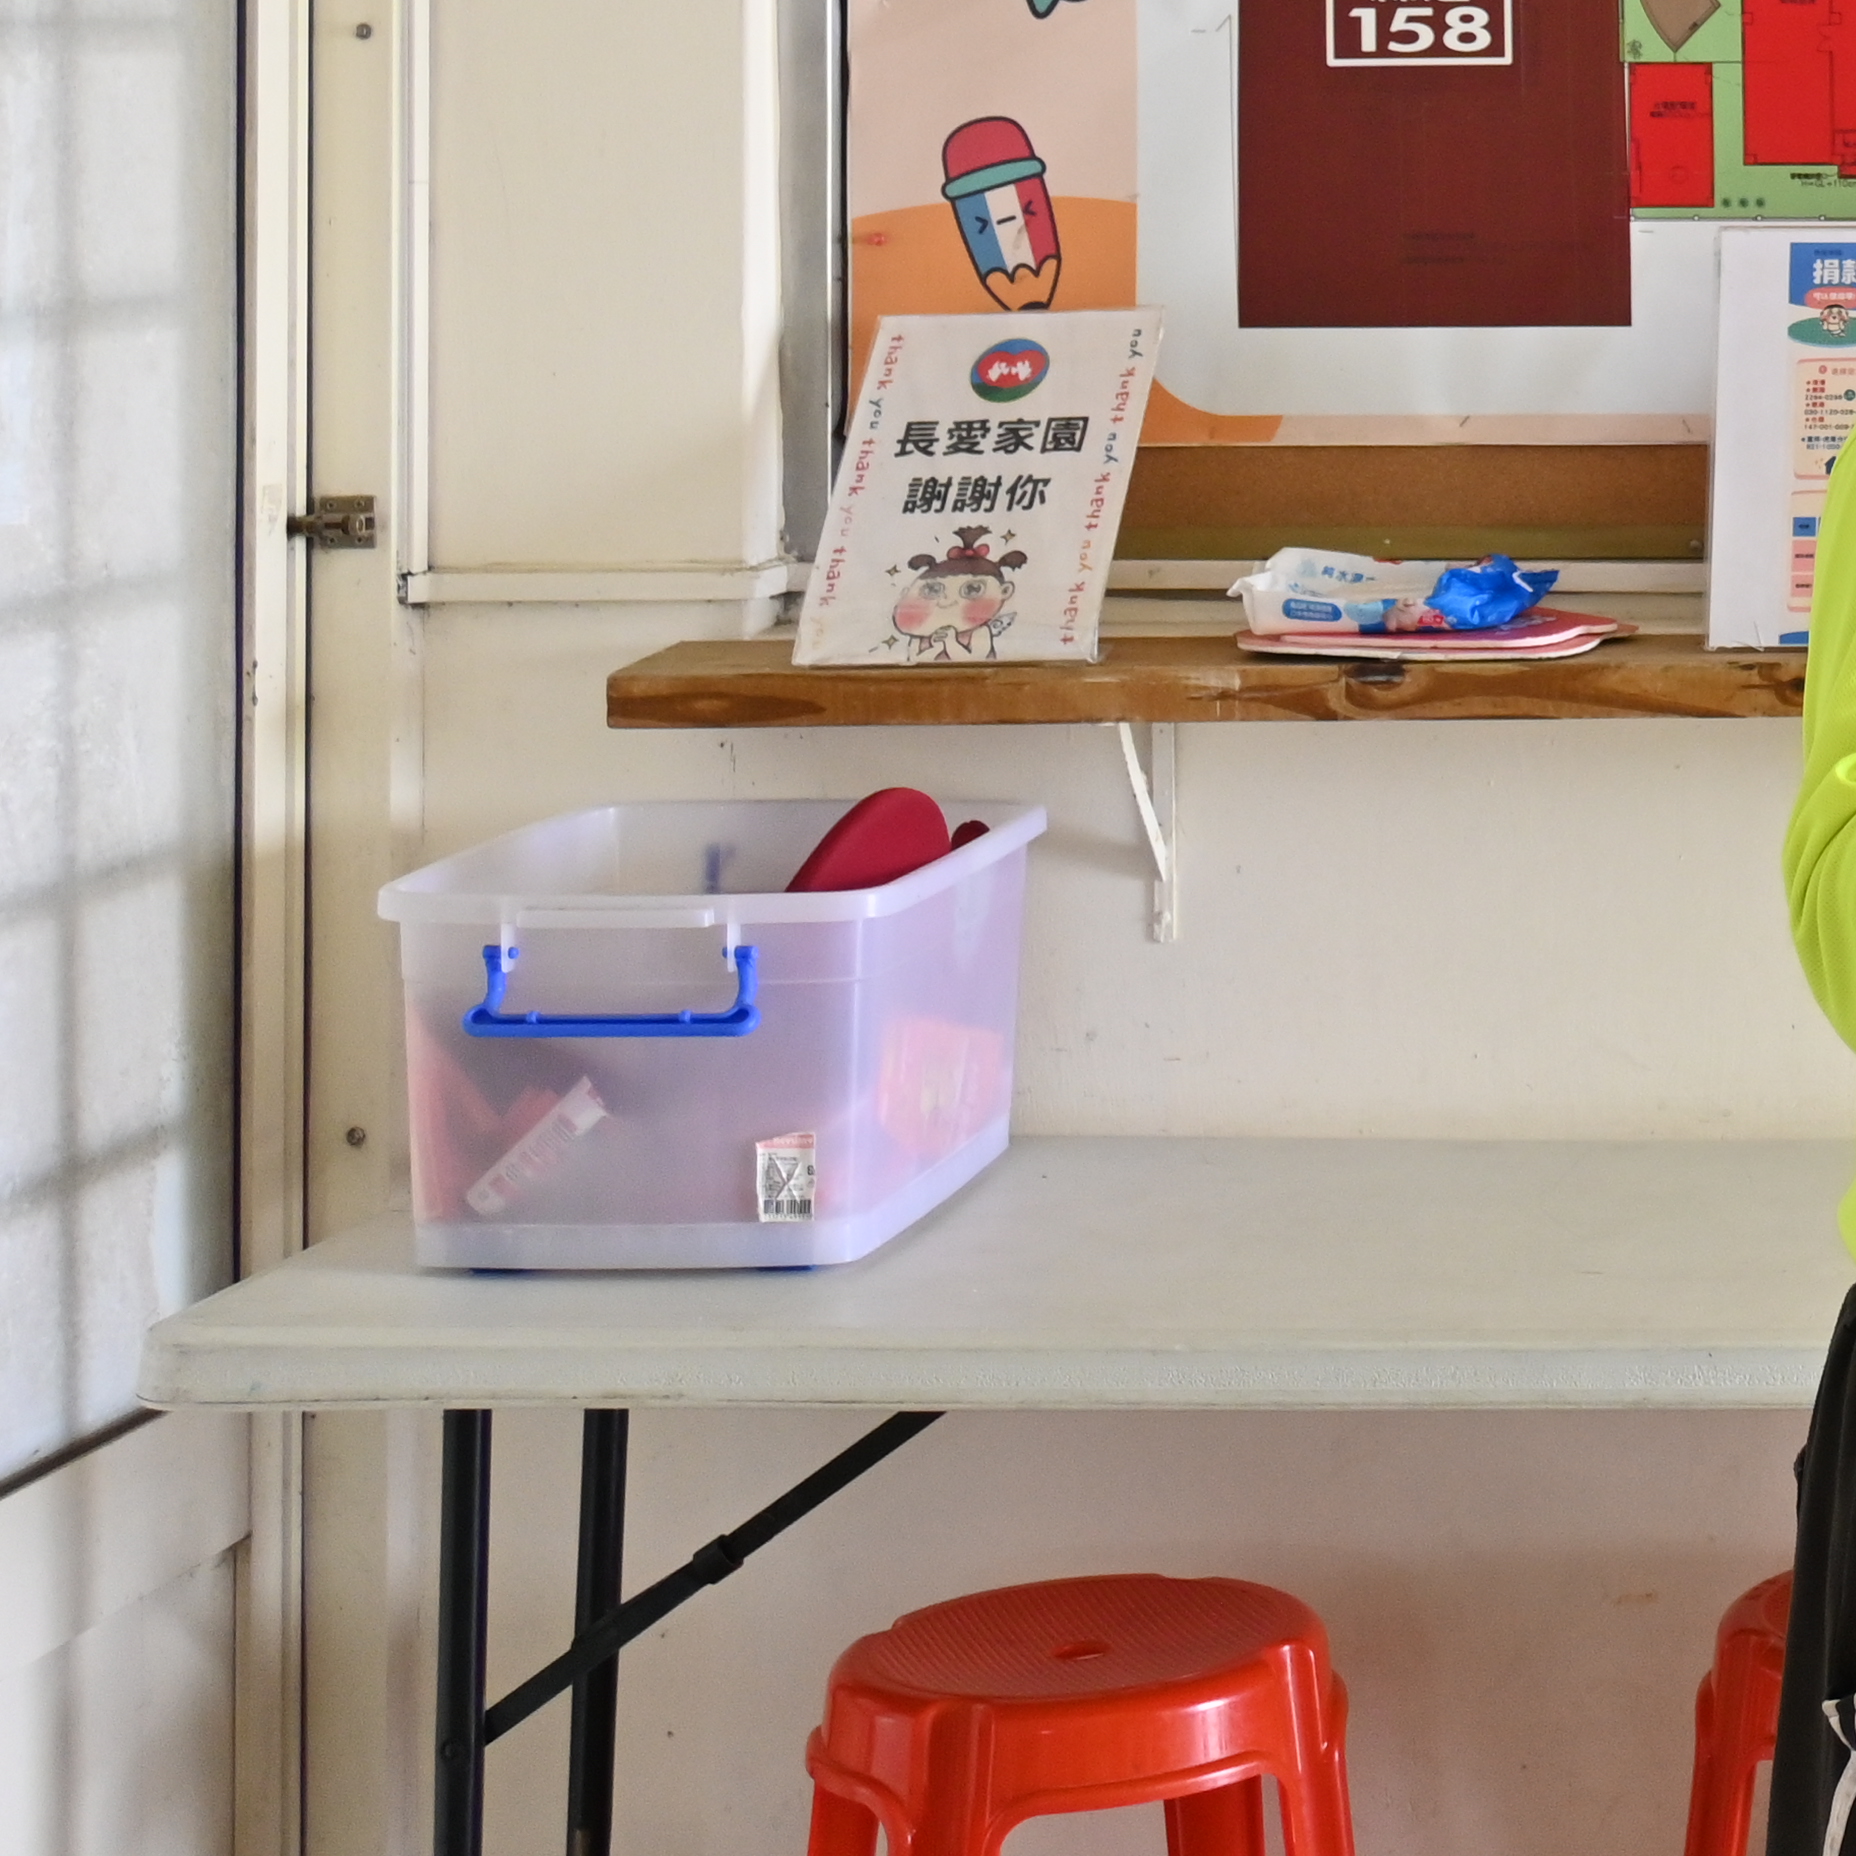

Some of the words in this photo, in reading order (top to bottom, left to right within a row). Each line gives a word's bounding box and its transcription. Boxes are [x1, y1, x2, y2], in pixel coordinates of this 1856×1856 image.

[1348, 7, 1492, 53] 158
[880, 334, 905, 390] thank
[1129, 327, 1144, 359] you
[868, 397, 884, 431] you
[1111, 365, 1136, 425] thank
[893, 415, 1090, 457] 長愛家園
[1103, 431, 1118, 466] you
[854, 437, 876, 497] thank
[902, 474, 1052, 514] 謝謝你
[1085, 470, 1112, 531] thank
[819, 545, 848, 608] thank
[1078, 536, 1093, 574] you
[1061, 580, 1087, 646] thank
